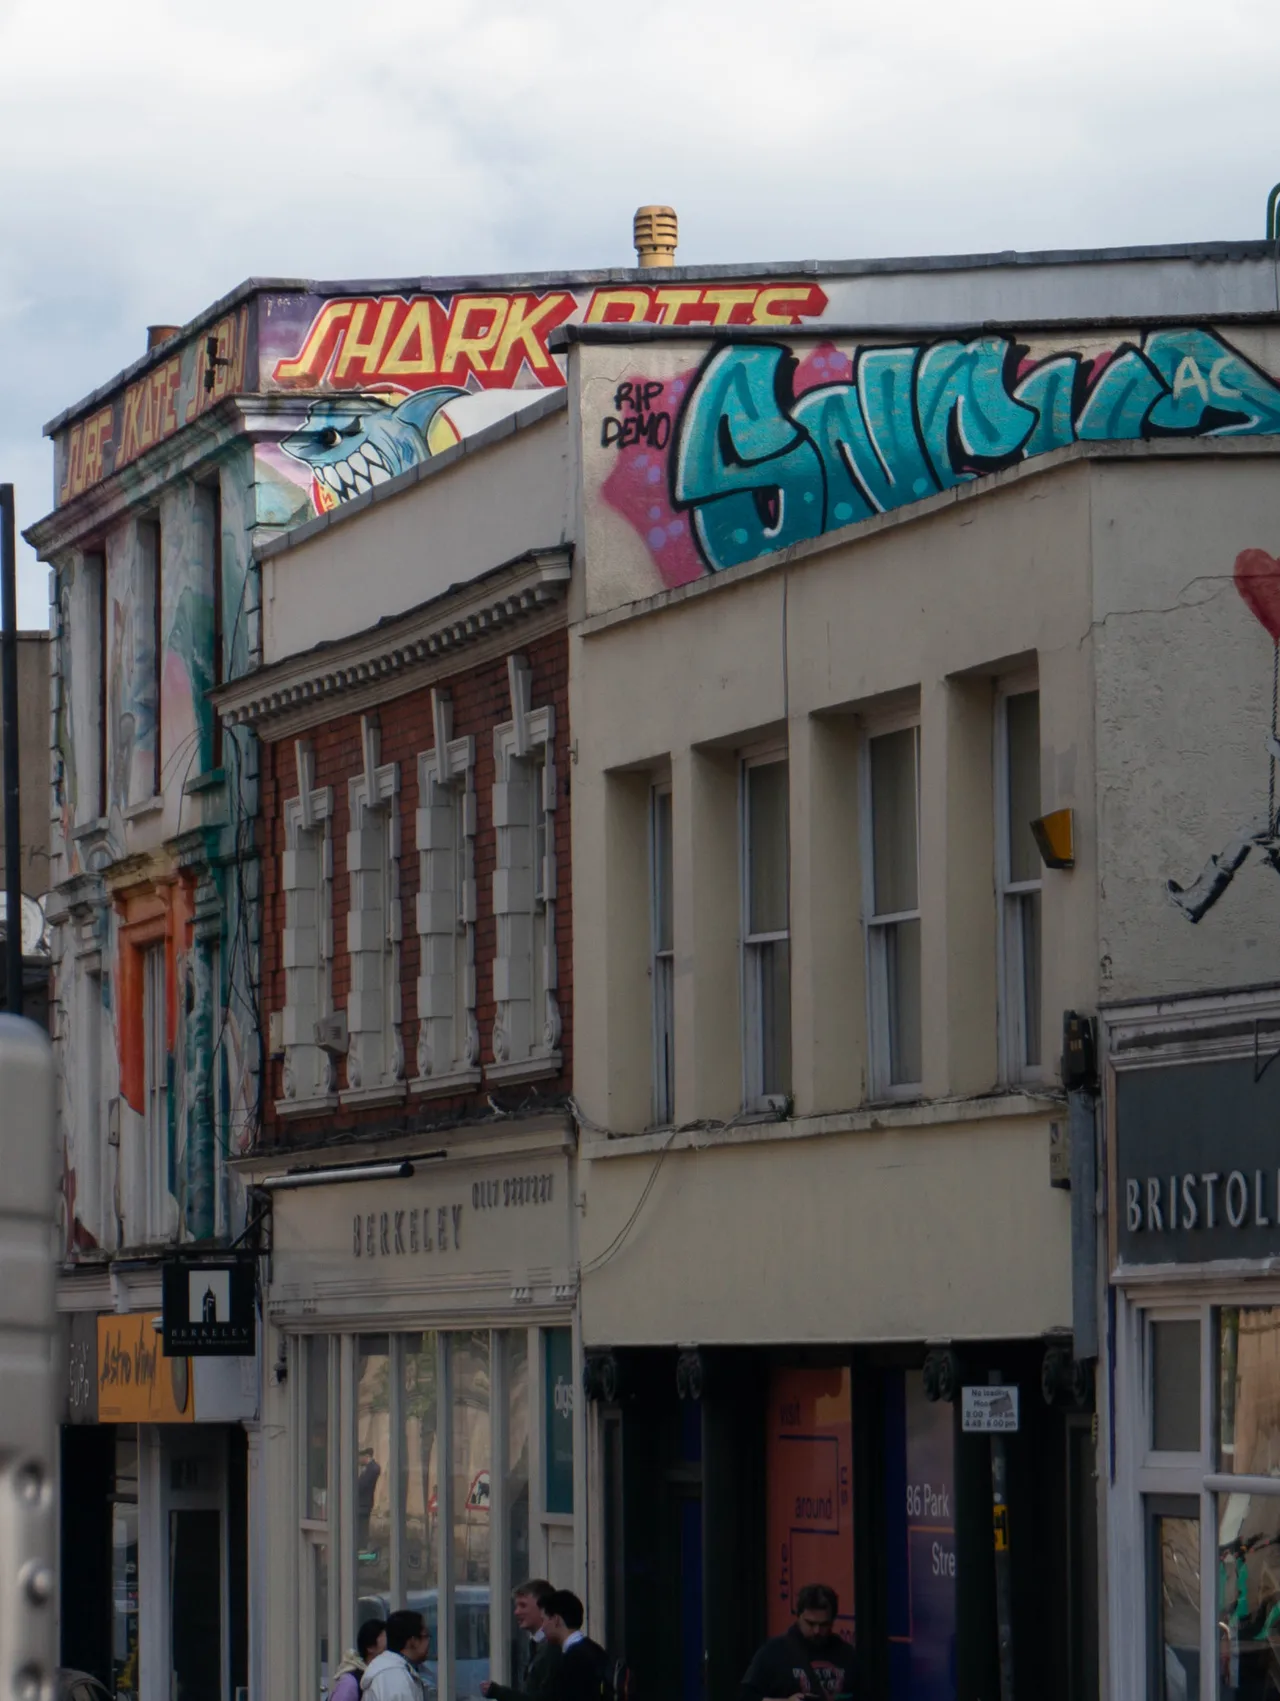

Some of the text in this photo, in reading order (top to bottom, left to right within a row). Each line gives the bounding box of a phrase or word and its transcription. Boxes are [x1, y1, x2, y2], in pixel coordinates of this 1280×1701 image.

[273, 292, 577, 387] SHARK
[614, 382, 664, 412] RIP
[61, 405, 113, 504] SURF
[115, 354, 180, 466] SKATE
[601, 412, 670, 449] DEMO
[353, 1203, 463, 1258] BERKELEY
[171, 1327, 249, 1337] BERKELEY
[100, 1329, 132, 1392] Astro
[795, 1490, 833, 1520] around
[906, 1483, 949, 1517] 86 Park
